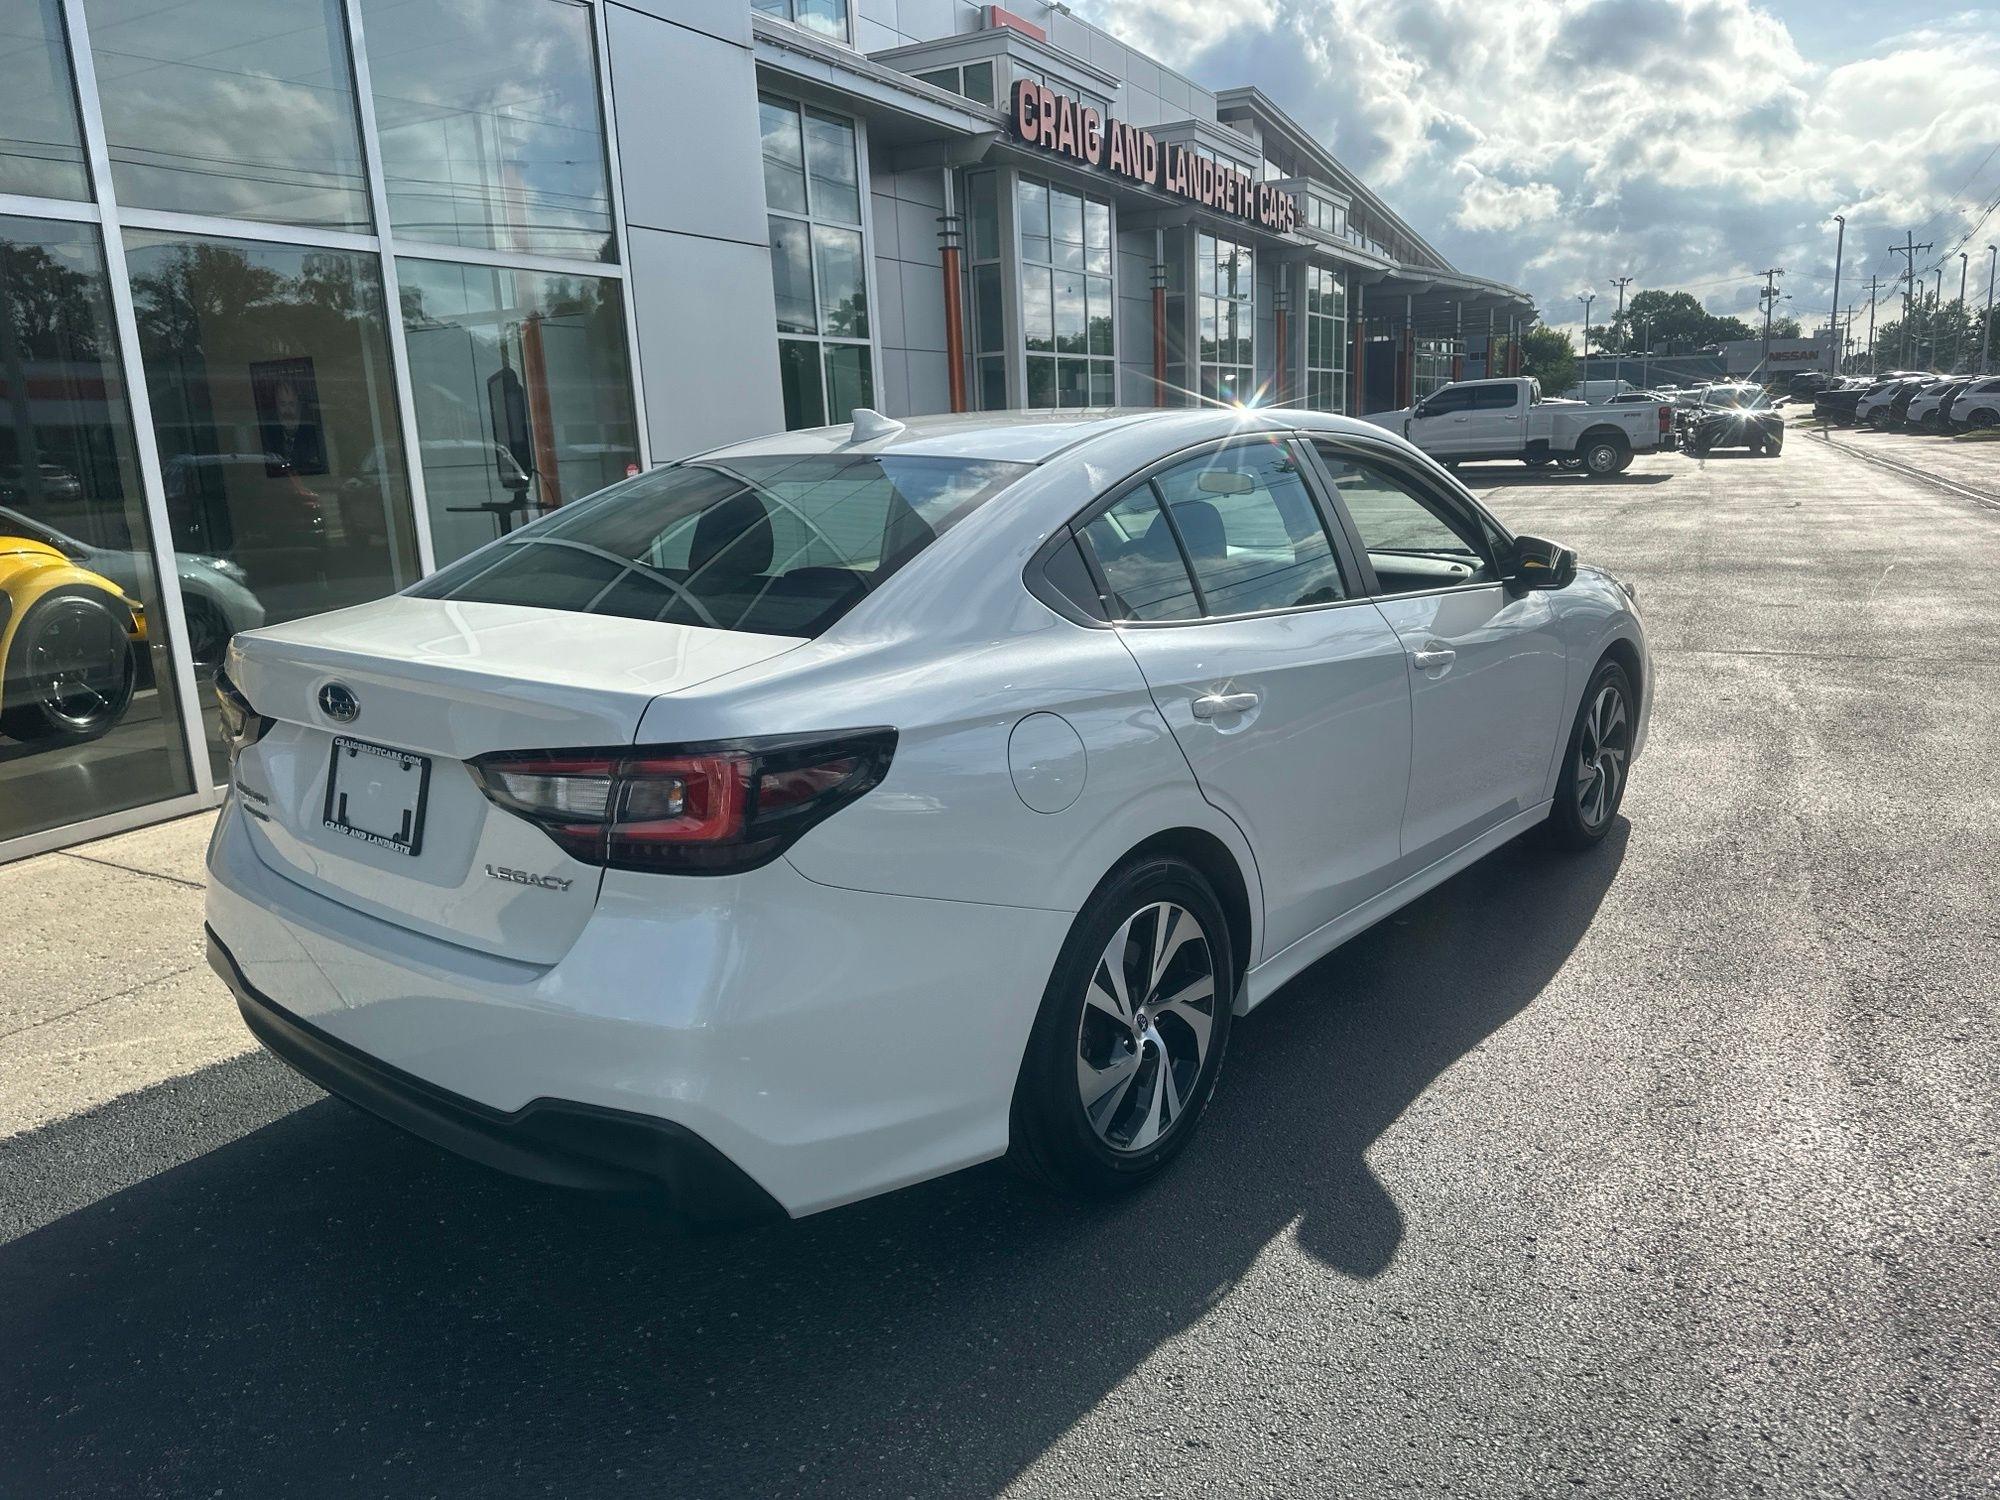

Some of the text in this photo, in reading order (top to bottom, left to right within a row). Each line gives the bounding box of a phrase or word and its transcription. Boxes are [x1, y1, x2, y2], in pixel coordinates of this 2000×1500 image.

[1018, 78, 1295, 234] CRAIG AND LANDRETH CARS
[1768, 350, 1819, 361] NISSAN
[334, 737, 423, 766] CRAIGSBESTCARS.COM
[324, 820, 411, 855] CRAIG AND LANDRETH
[485, 863, 574, 892] LEGACY
